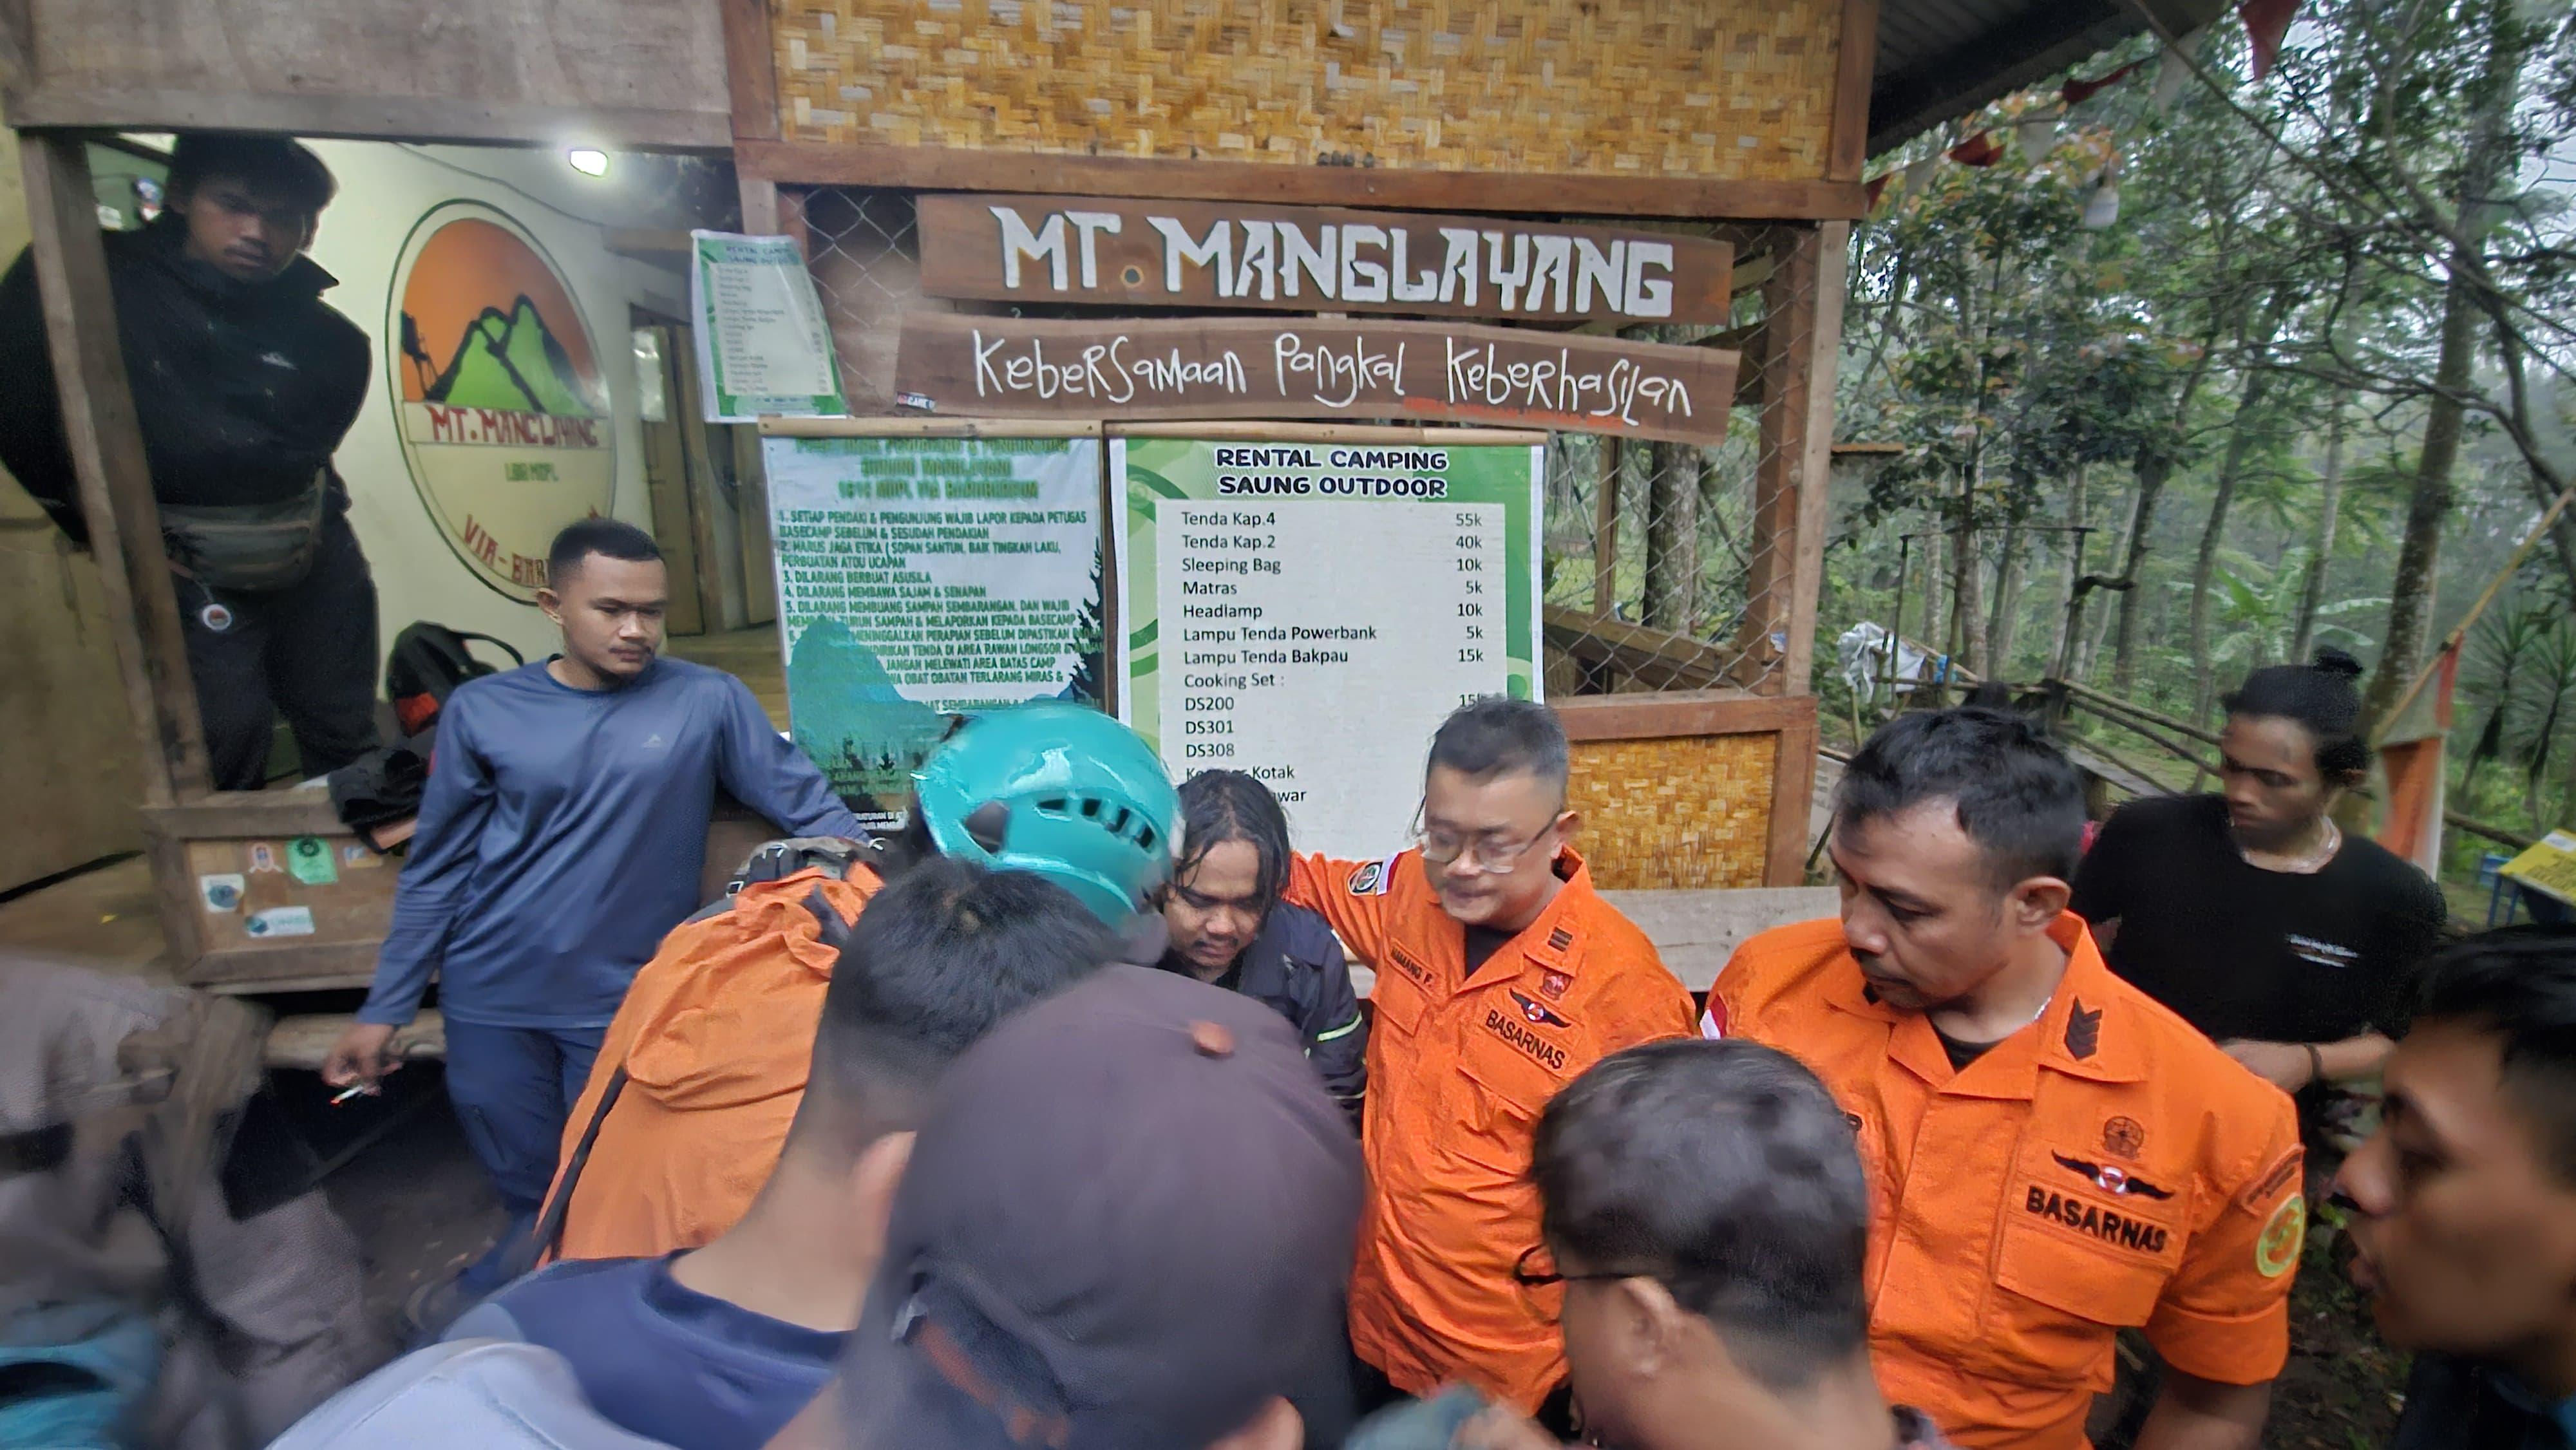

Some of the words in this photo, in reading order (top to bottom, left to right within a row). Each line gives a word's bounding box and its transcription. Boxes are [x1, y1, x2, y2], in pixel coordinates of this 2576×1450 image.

[989, 205, 1144, 291] MT.
[1147, 216, 1673, 317] MANGLAYANG
[1217, 448, 1321, 468] RENTAL
[1331, 449, 1447, 470] CAMPING
[1219, 476, 1310, 495] SAUNG
[1319, 477, 1447, 497] OUTDOOR
[945, 512, 973, 524] WAJIB
[977, 512, 1007, 523] LAPOR
[1010, 511, 1045, 523] KEPADA
[1047, 511, 1087, 523] PETUGAS
[1181, 511, 1228, 526] Tenda
[1233, 511, 1276, 529] Kap.4
[1456, 513, 1482, 527] 55k
[891, 527, 934, 540] SESUDAH
[855, 541, 882, 553] ETIKA
[892, 541, 923, 554] SOPAN
[1182, 534, 1228, 549] Tenda
[1233, 534, 1275, 552] Kap.2
[1455, 535, 1482, 549] 40k
[869, 556, 905, 568] UCAPAN
[1182, 556, 1248, 576] Sleeping
[1253, 558, 1282, 575] Bag
[1457, 557, 1482, 572] 10k
[795, 571, 844, 583] DILARANG
[847, 572, 889, 583] BERBUAT
[797, 585, 845, 598] DILARANG
[848, 586, 897, 598] MEMBAWA
[900, 587, 931, 598] SAJAM
[944, 586, 986, 598] SENAPAN
[1183, 581, 1237, 595] Matras
[1466, 579, 1483, 594] 5k
[798, 601, 846, 612] DILARANG
[849, 601, 902, 612] MEMBUANG
[905, 600, 943, 612] SAMPAH
[1020, 599, 1039, 611] DAN
[1042, 599, 1070, 612] WAJIB
[1183, 603, 1263, 621] Headlamp
[1457, 602, 1483, 617] 10k
[875, 615, 913, 627] SAMPAH
[992, 614, 1025, 626] KEPADA
[1028, 614, 1076, 626] BASECAMP
[974, 628, 1015, 641] SEBELUM
[1018, 627, 1070, 639] DIPASTIKAN
[1184, 628, 1236, 645] Lampu
[1240, 626, 1287, 641] Tenda
[1291, 625, 1377, 641] Powerbank
[1466, 625, 1483, 639] 5k
[913, 645, 943, 656] TENDA
[958, 644, 981, 655] AREA
[1184, 651, 1236, 668] Lampu
[1240, 648, 1287, 664] Tenda
[1292, 647, 1349, 666] Bakpau
[1458, 648, 1484, 663] 15k
[973, 657, 998, 669] AREA
[1000, 657, 1028, 669] BATAS
[1030, 657, 1056, 668] CAMP
[904, 673, 929, 684] OBAT
[971, 672, 1023, 683] TERLARANG
[1184, 673, 1247, 690] Cooking
[1251, 672, 1275, 686] Set
[1185, 696, 1235, 711] DS200
[1185, 720, 1234, 735] DS301
[1186, 742, 1235, 758] DS308
[1252, 764, 1294, 780] Kotak
[1486, 1008, 1566, 1069] BASARNAS
[2025, 1185, 2167, 1253] BASARNAS
